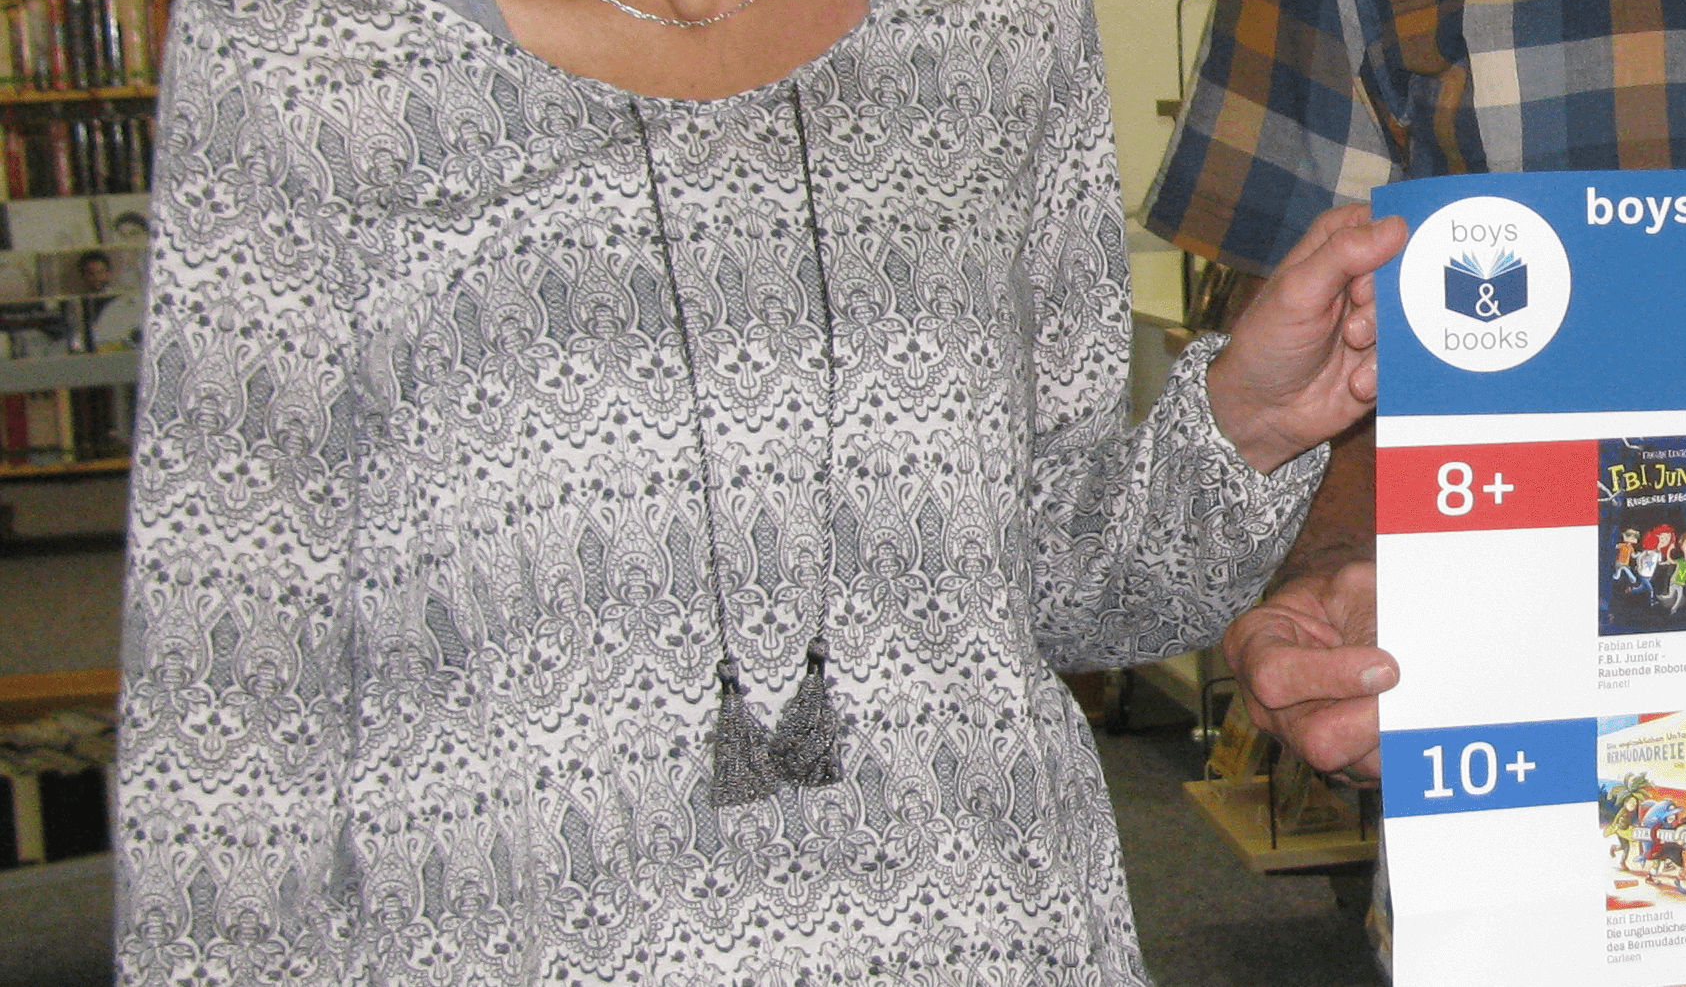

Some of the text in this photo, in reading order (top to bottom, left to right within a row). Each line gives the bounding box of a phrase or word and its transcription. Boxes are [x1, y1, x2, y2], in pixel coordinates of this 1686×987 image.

[1451, 221, 1518, 245] boys
[1475, 283, 1500, 316] &
[1444, 328, 1528, 351] books
[1436, 461, 1514, 516] 8+
[1598, 639, 1661, 651] Fabian Lenk
[1624, 652, 1659, 663] Junior
[1598, 667, 1651, 678] Raubende
[1423, 741, 1536, 799] 10+
[1629, 911, 1674, 924] Ehrhardt
[1606, 929, 1621, 939] Die
[1606, 942, 1625, 952] des
